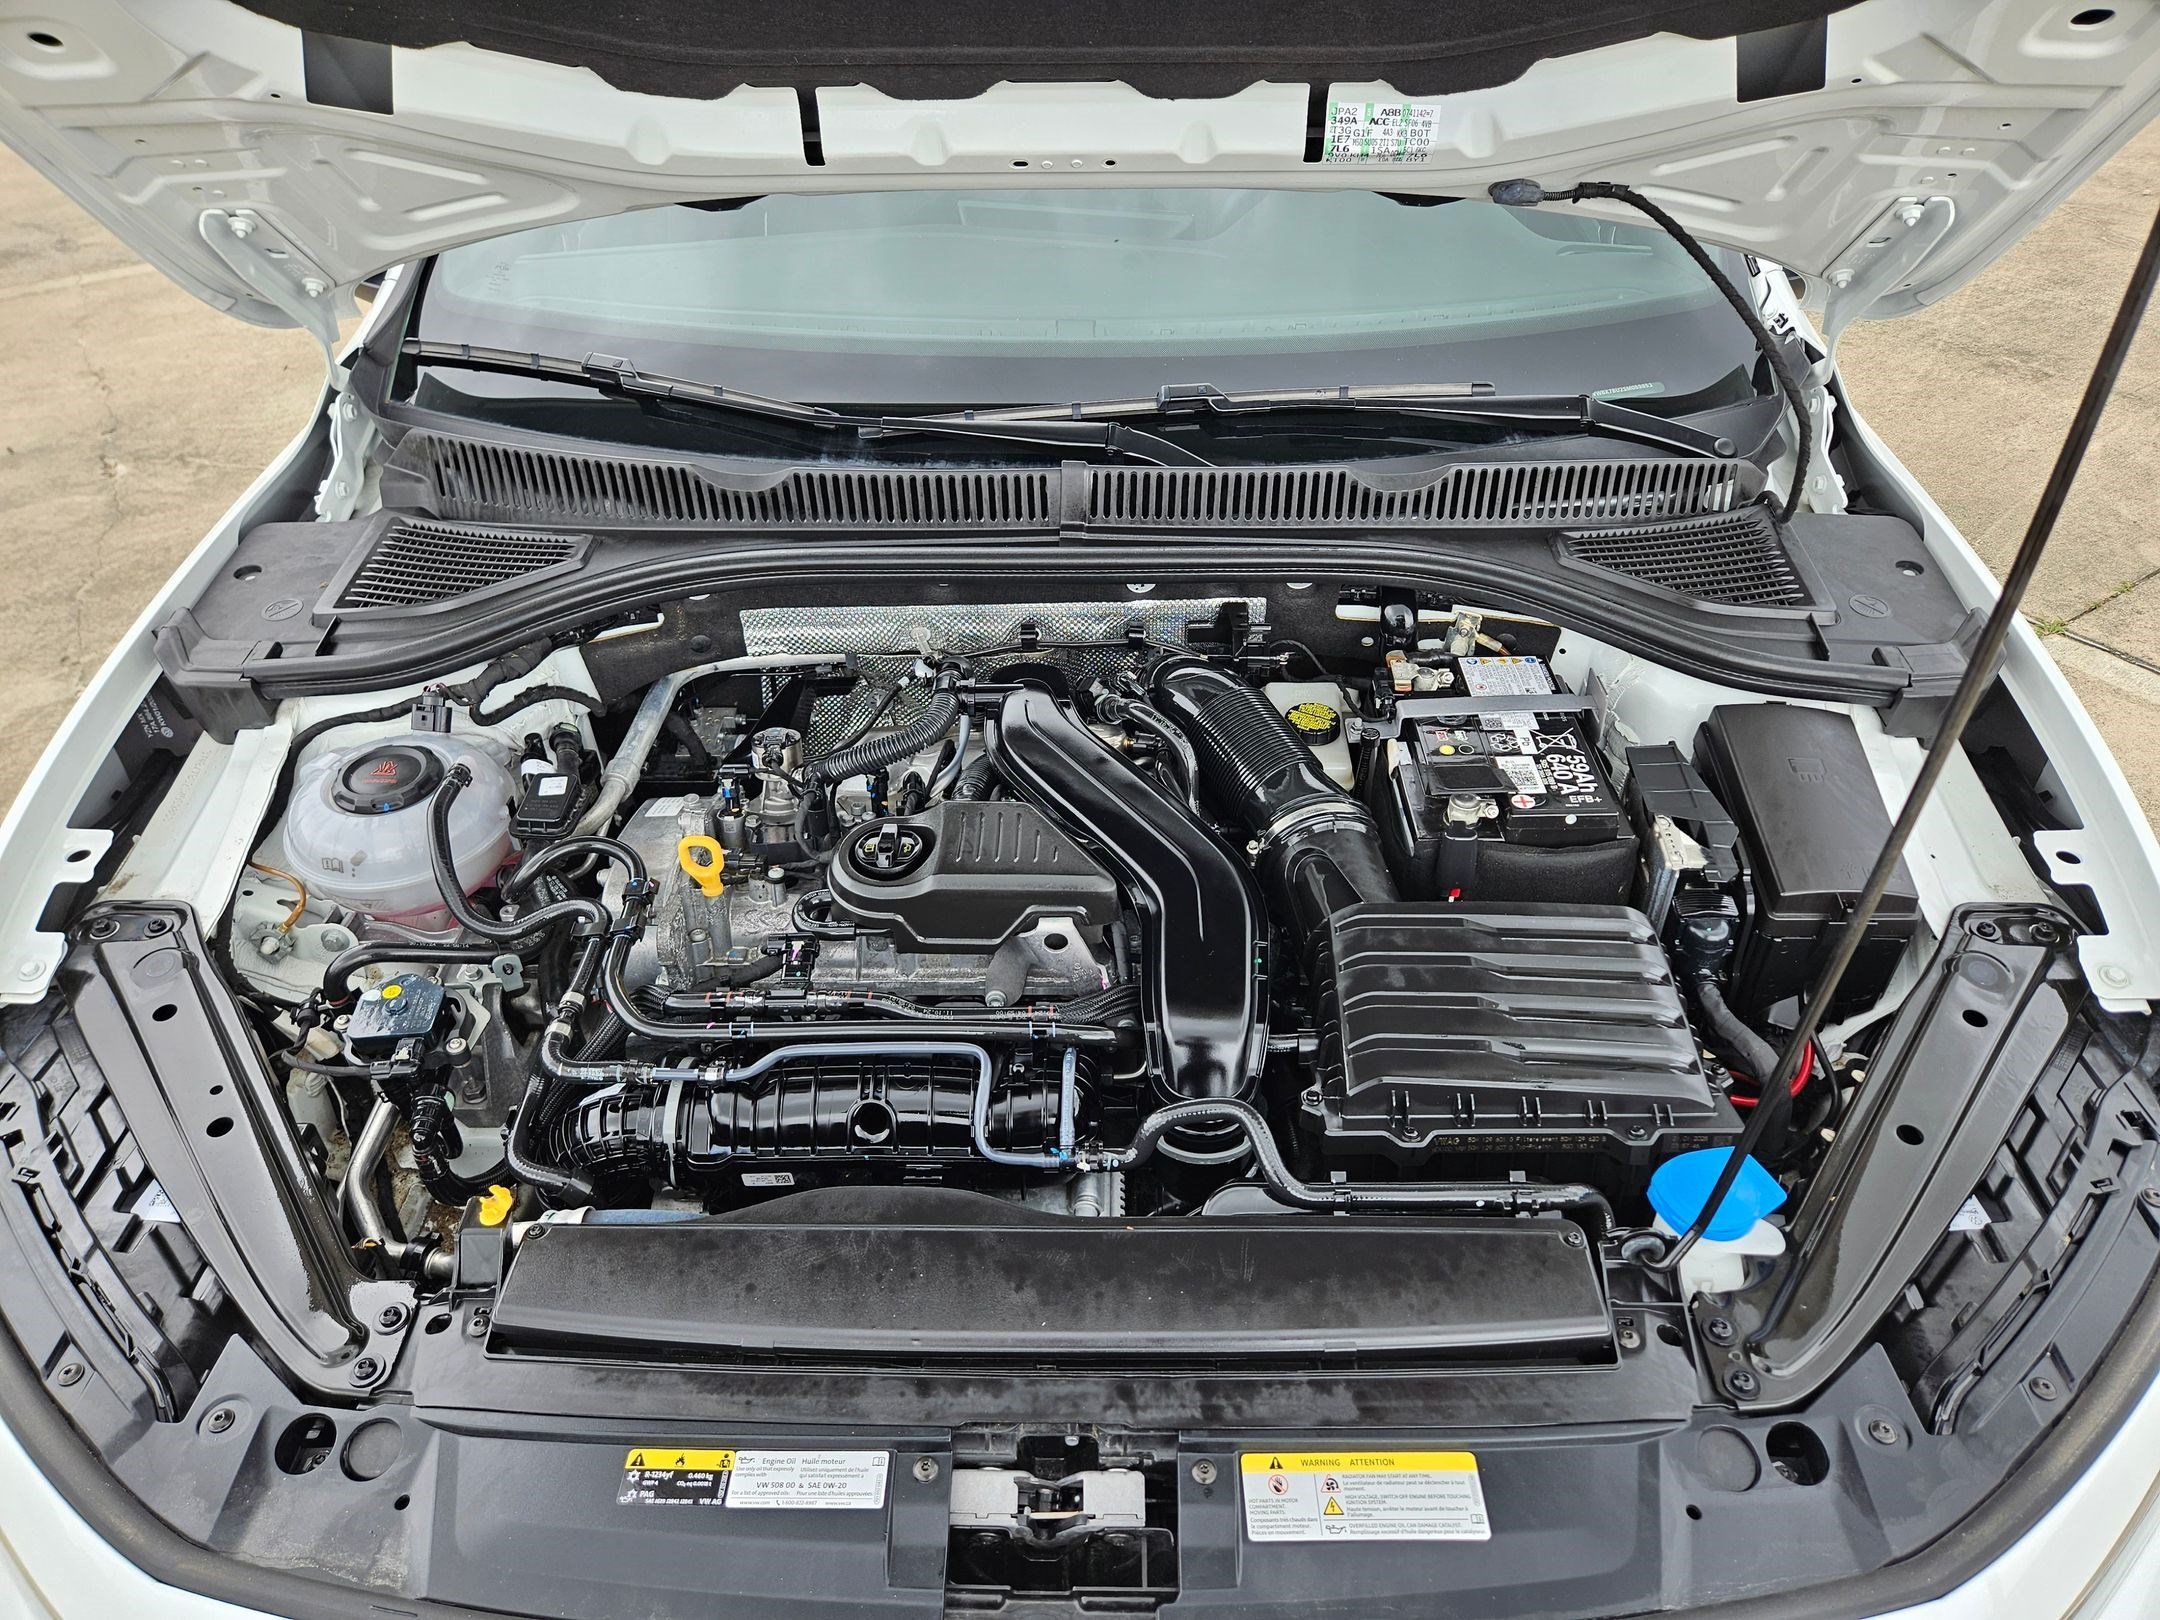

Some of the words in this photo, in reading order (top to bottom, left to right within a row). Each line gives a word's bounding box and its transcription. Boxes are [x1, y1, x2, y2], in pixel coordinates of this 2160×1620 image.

[1331, 107, 1358, 116] JPA2
[1330, 117, 1357, 125] 349A
[1369, 117, 1390, 126] ACC
[1331, 135, 1351, 144] 1E7
[1330, 145, 1350, 153] 7L6
[1520, 736, 1531, 747] Pb
[1546, 754, 1574, 780] 640
[1566, 755, 1599, 793] 59Ah
[1557, 783, 1580, 795] A
[1569, 795, 1602, 804] EFB+
[762, 1458, 785, 1466] Engine
[801, 1457, 820, 1465] Huile
[1350, 1458, 1395, 1466] ATTENTION
[644, 1471, 674, 1480] R-1234yf
[639, 1490, 655, 1498] PAG
